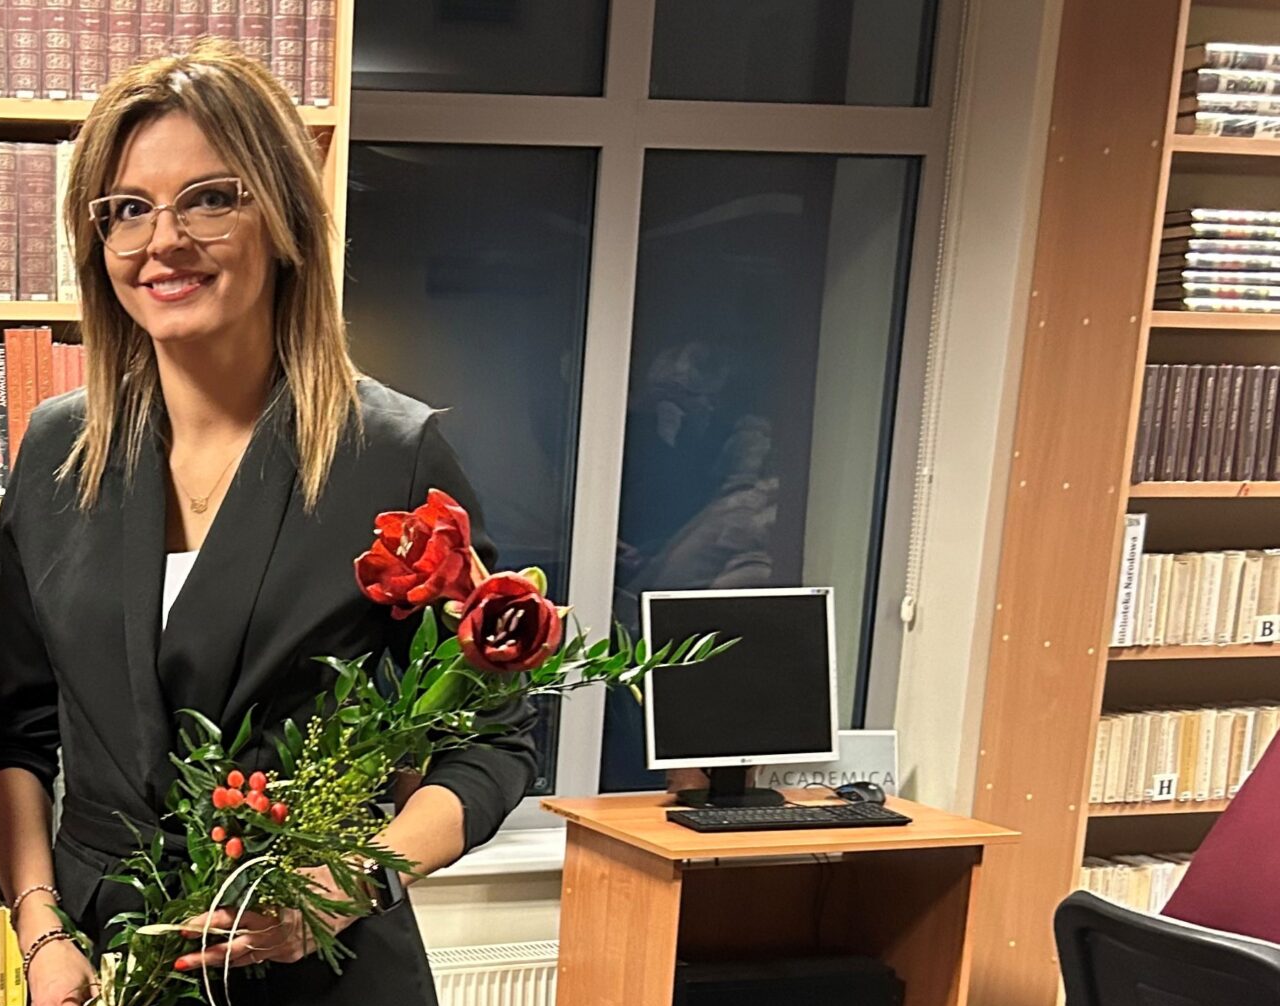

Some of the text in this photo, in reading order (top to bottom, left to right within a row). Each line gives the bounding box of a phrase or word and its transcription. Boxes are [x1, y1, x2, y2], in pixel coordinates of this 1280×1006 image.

[1117, 536, 1138, 644] Biblioteka Narodowa
[1261, 620, 1274, 637] B
[768, 771, 895, 786] ACADEMICA
[1158, 779, 1173, 796] H
